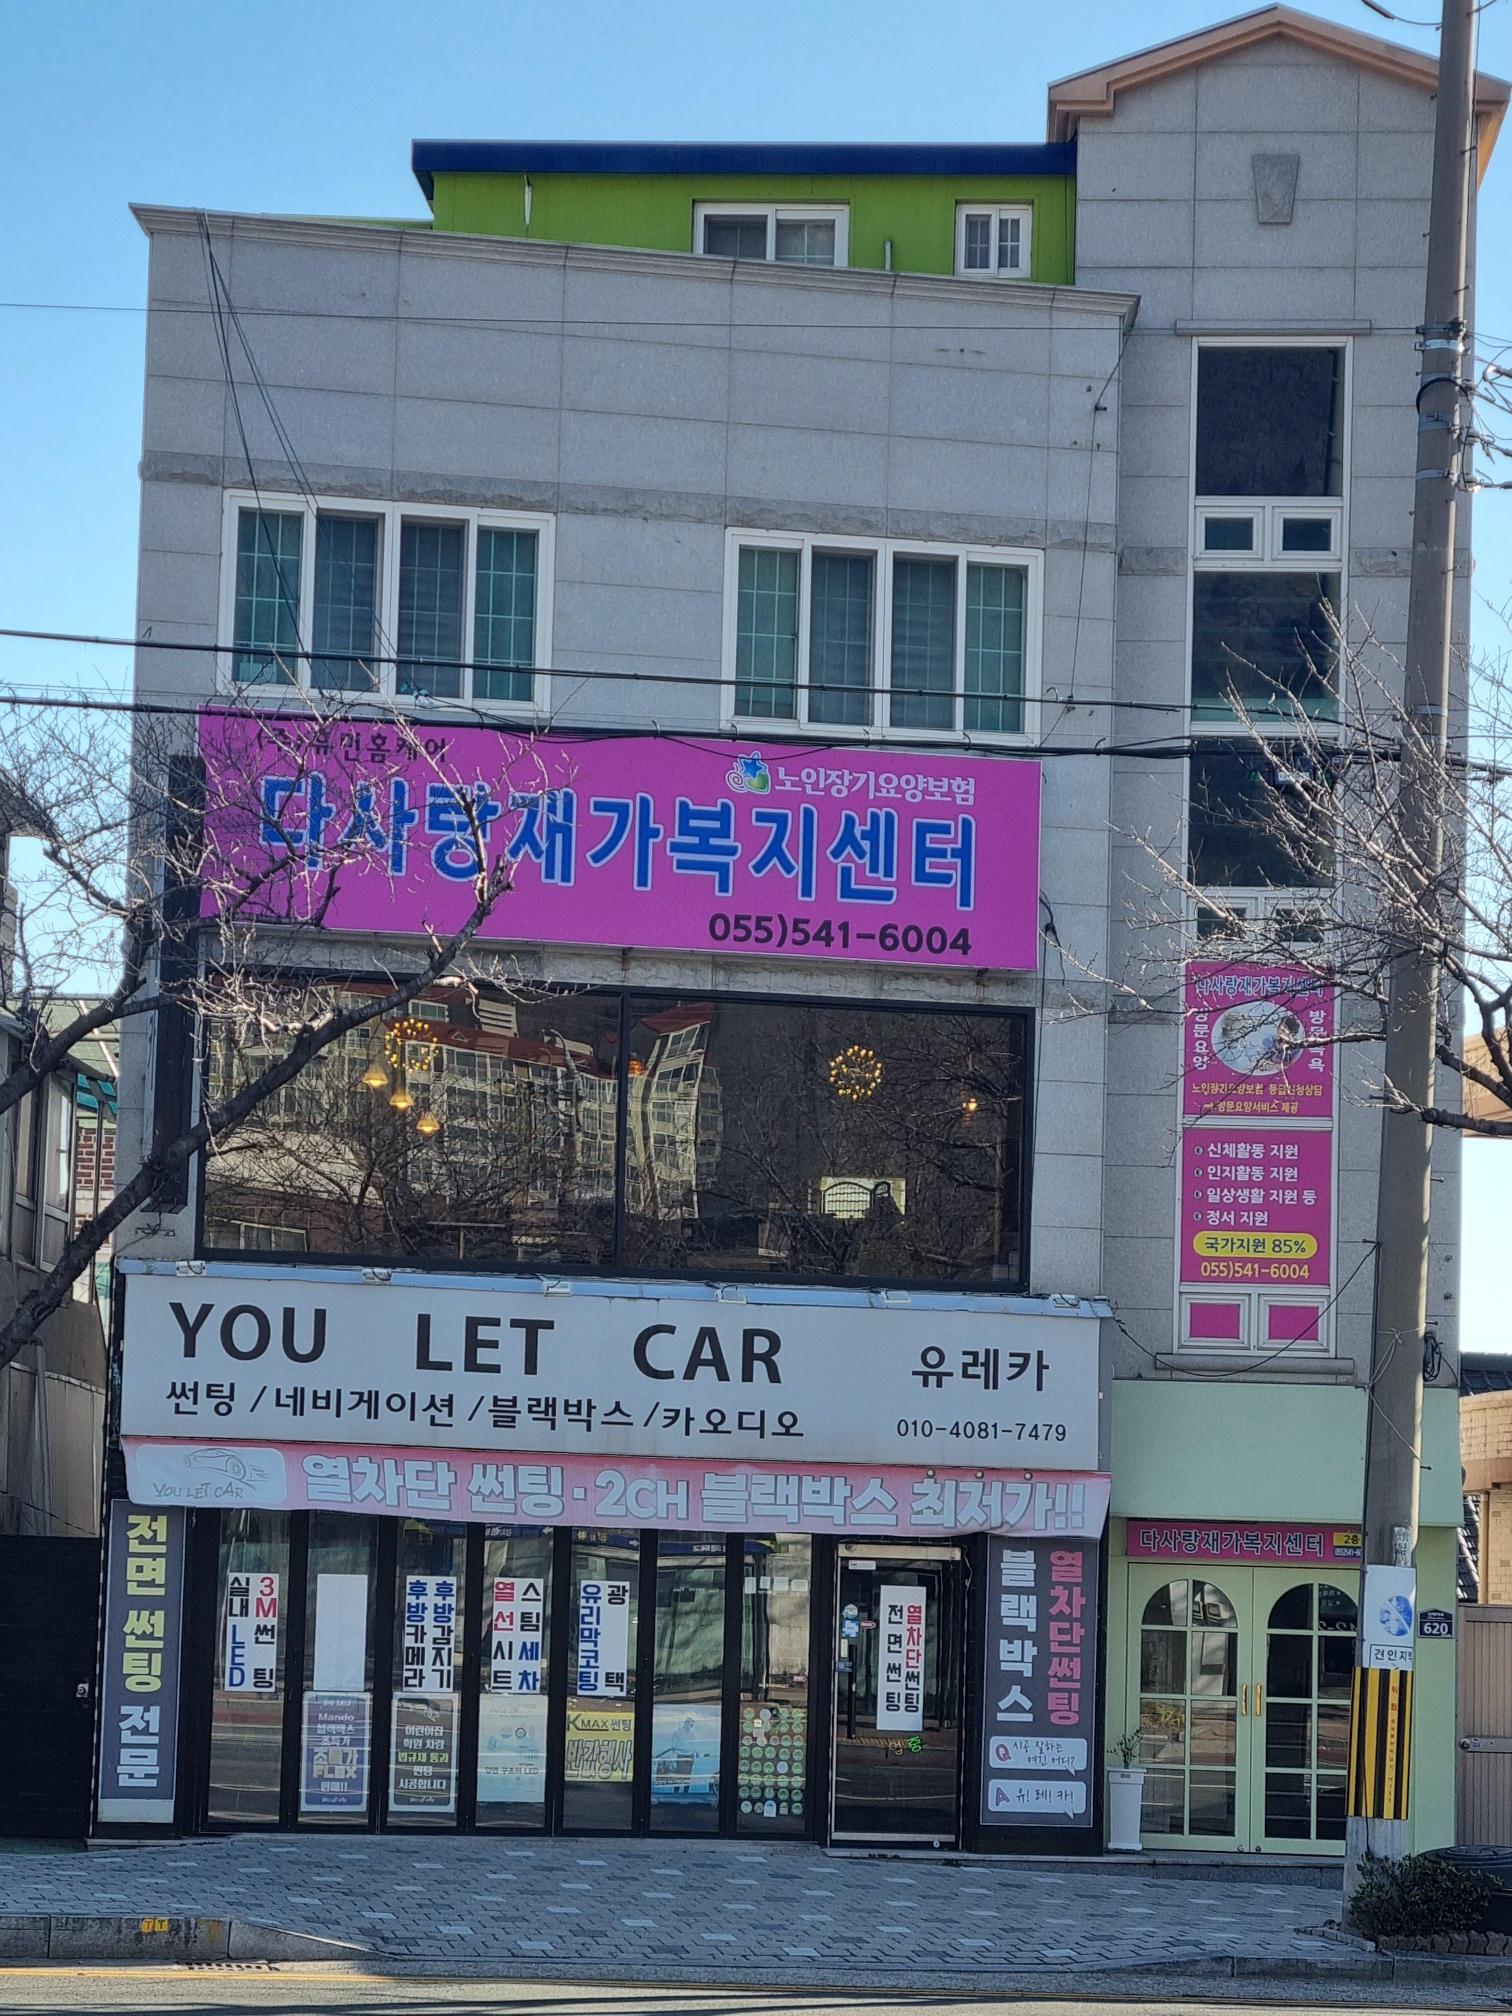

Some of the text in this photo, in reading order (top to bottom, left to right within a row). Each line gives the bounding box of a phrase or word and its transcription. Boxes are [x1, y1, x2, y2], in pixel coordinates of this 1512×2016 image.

[775, 767, 976, 806] 노인장기요양보험
[260, 771, 976, 911] 다사랑재가복지센터
[708, 913, 973, 956] 055)541-6004
[1207, 1143, 1299, 1160] 신체활동 지원
[1207, 1166, 1299, 1182] 인지활동 지원
[1206, 1188, 1317, 1205] 일상생활 지원 등
[1206, 1211, 1269, 1226] 정서 지원
[1205, 1237, 1306, 1254] 국가지원 85%
[1201, 1262, 1309, 1279] 055)541-6004
[169, 1302, 783, 1385] YOU LET CAR
[912, 1345, 1050, 1392] 유레카
[896, 1418, 1067, 1442] 010-4081-7479
[152, 1481, 245, 1499] YOU LET CAR
[301, 1453, 457, 1511] 열차단
[701, 1471, 899, 1527] 블랙박스
[910, 1475, 1086, 1531] 최저가!!
[1139, 1528, 1325, 1556] 다사랑재가복지센터
[1344, 1534, 1360, 1545] 2층
[255, 1576, 277, 1618] 3M
[229, 1576, 250, 1688] 실내 LED
[996, 1549, 1038, 1723] 블랙박스
[1423, 1622, 1449, 1635] 620
[318, 1713, 355, 1722] Mando
[567, 1714, 609, 1731] KMAX
[116, 1705, 161, 1788] 전문
[1013, 1740, 1030, 1753] 시공
[1034, 1740, 1063, 1754] 잘하는
